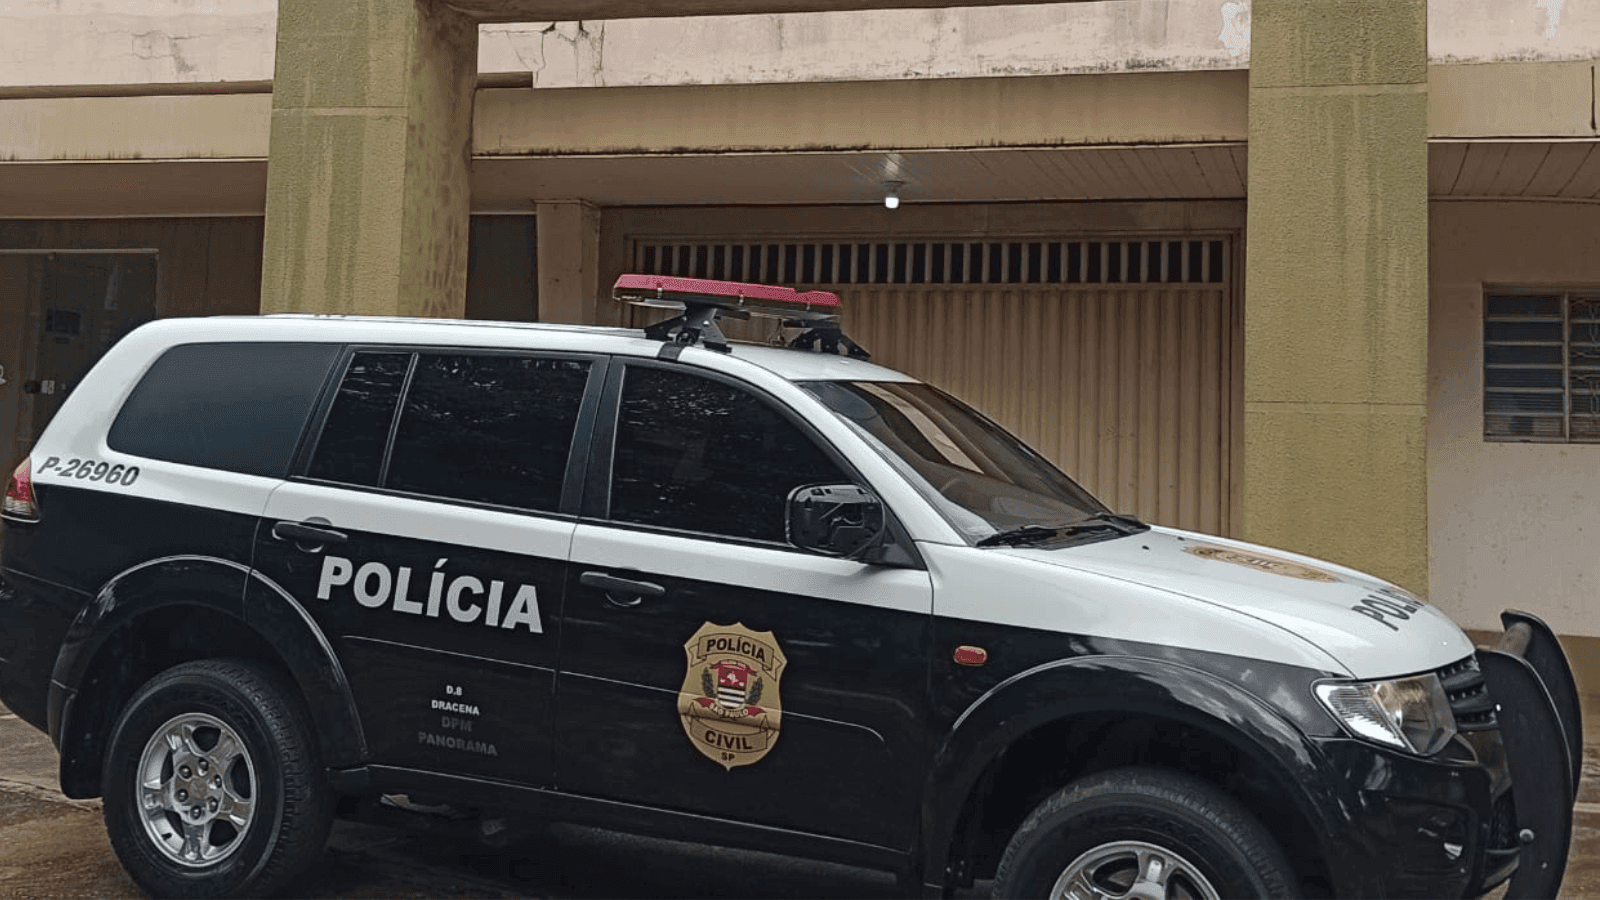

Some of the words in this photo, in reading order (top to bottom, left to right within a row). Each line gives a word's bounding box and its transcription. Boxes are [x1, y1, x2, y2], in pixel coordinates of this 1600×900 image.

[37, 457, 140, 486] P-26960
[317, 556, 543, 633] POLÍCIA
[706, 638, 766, 662] POLÍCIA
[431, 699, 480, 715] DRACENA
[418, 731, 498, 756] PANORAMA
[704, 730, 753, 750] CIVIL
[721, 752, 735, 761] SP
